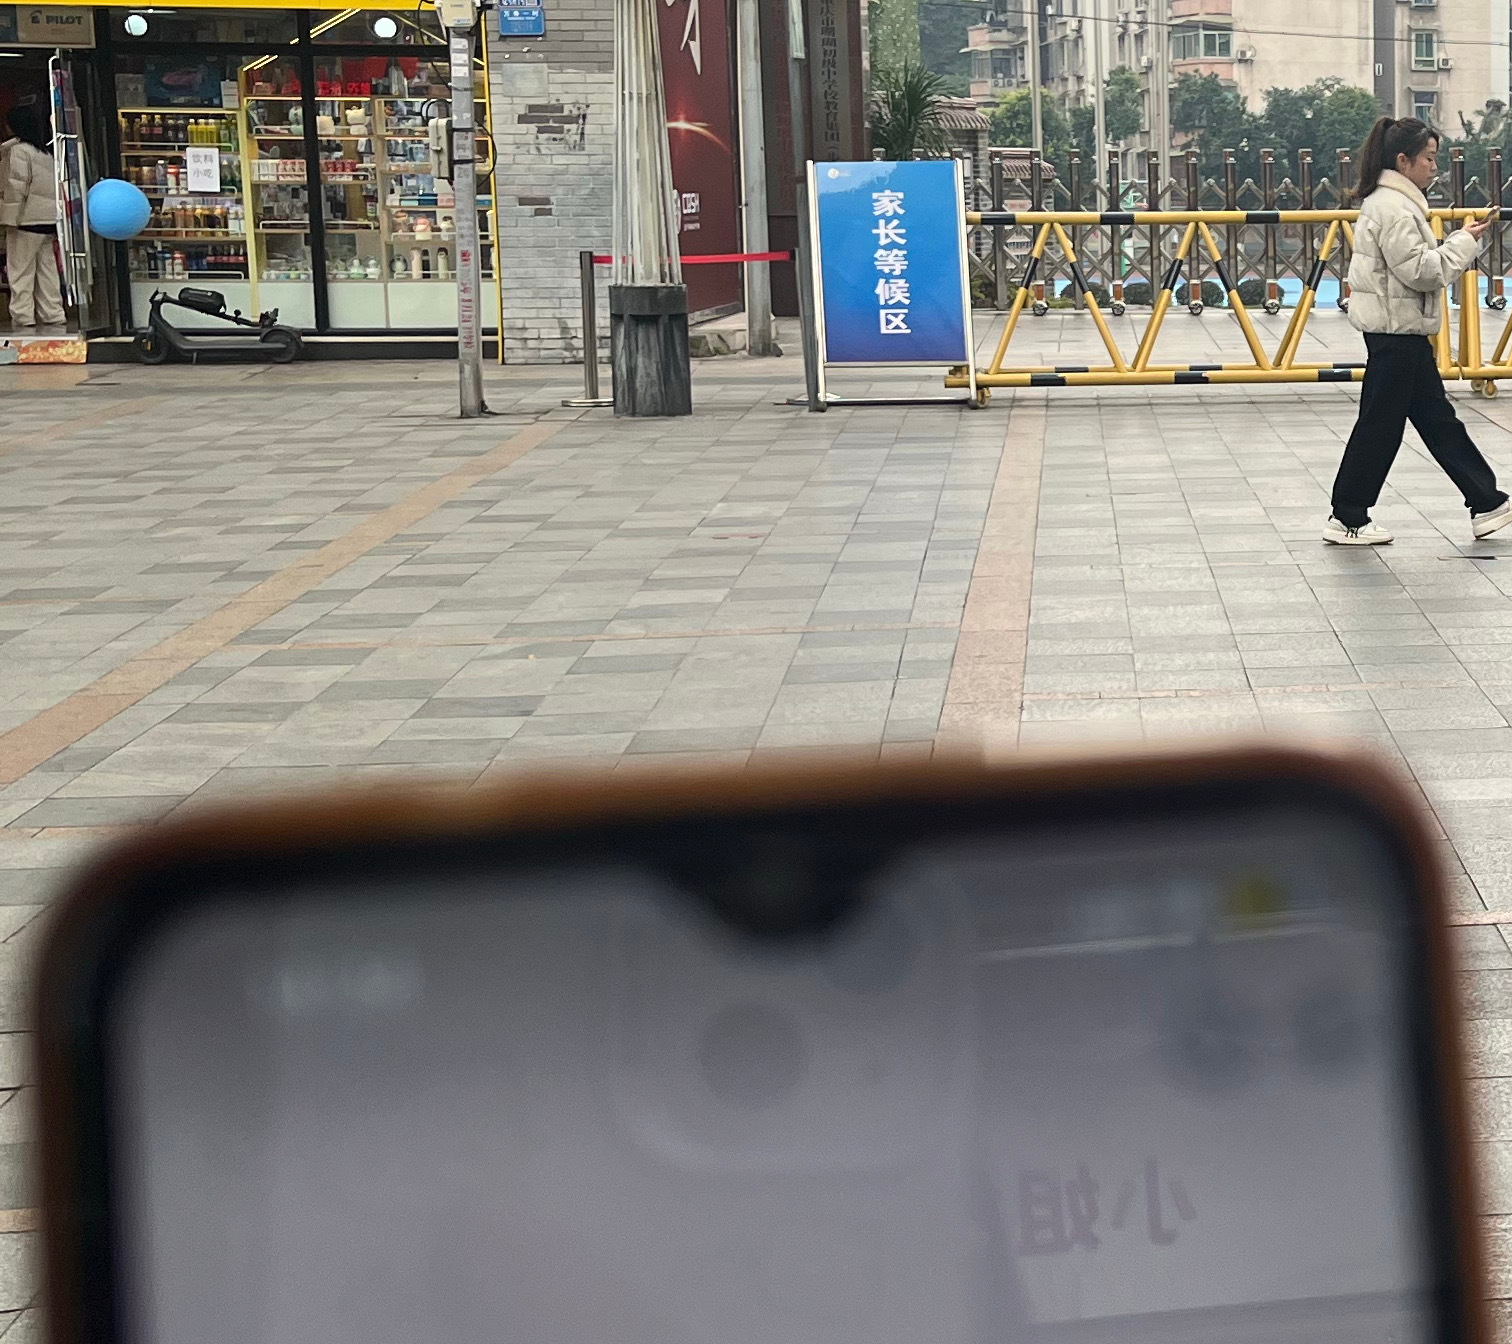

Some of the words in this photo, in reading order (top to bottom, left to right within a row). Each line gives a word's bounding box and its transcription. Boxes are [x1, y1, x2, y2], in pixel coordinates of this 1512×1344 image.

[45, 15, 83, 25] PILOT
[871, 189, 912, 335] 家长等候区
